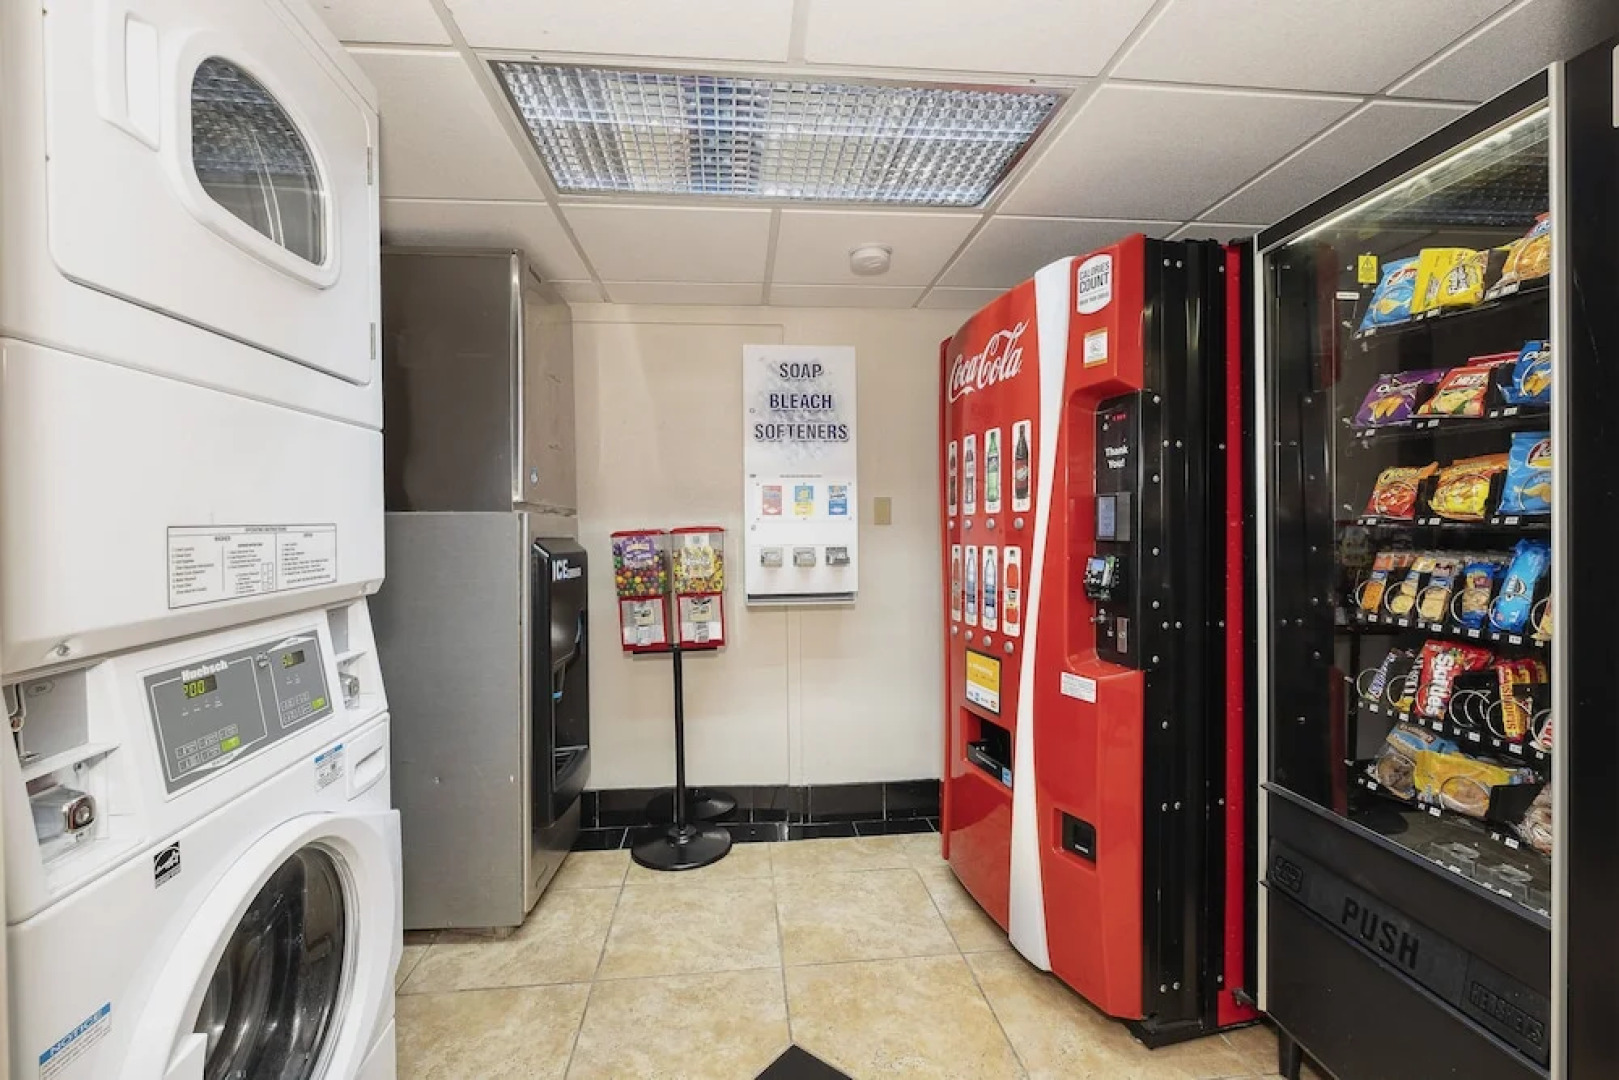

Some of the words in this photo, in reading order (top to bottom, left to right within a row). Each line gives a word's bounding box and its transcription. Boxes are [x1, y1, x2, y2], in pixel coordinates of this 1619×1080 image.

[1079, 260, 1110, 281] CALORIES
[1079, 271, 1110, 294] COUNT
[779, 362, 824, 380] SOAP
[769, 393, 833, 410] BLEACH
[754, 423, 849, 441] SOFTENERS
[1104, 445, 1129, 457] Thank
[551, 559, 569, 583] ICE
[181, 660, 228, 682] Huebsch
[1342, 897, 1419, 970] PUSH
[49, 1009, 103, 1055] NOTICE
